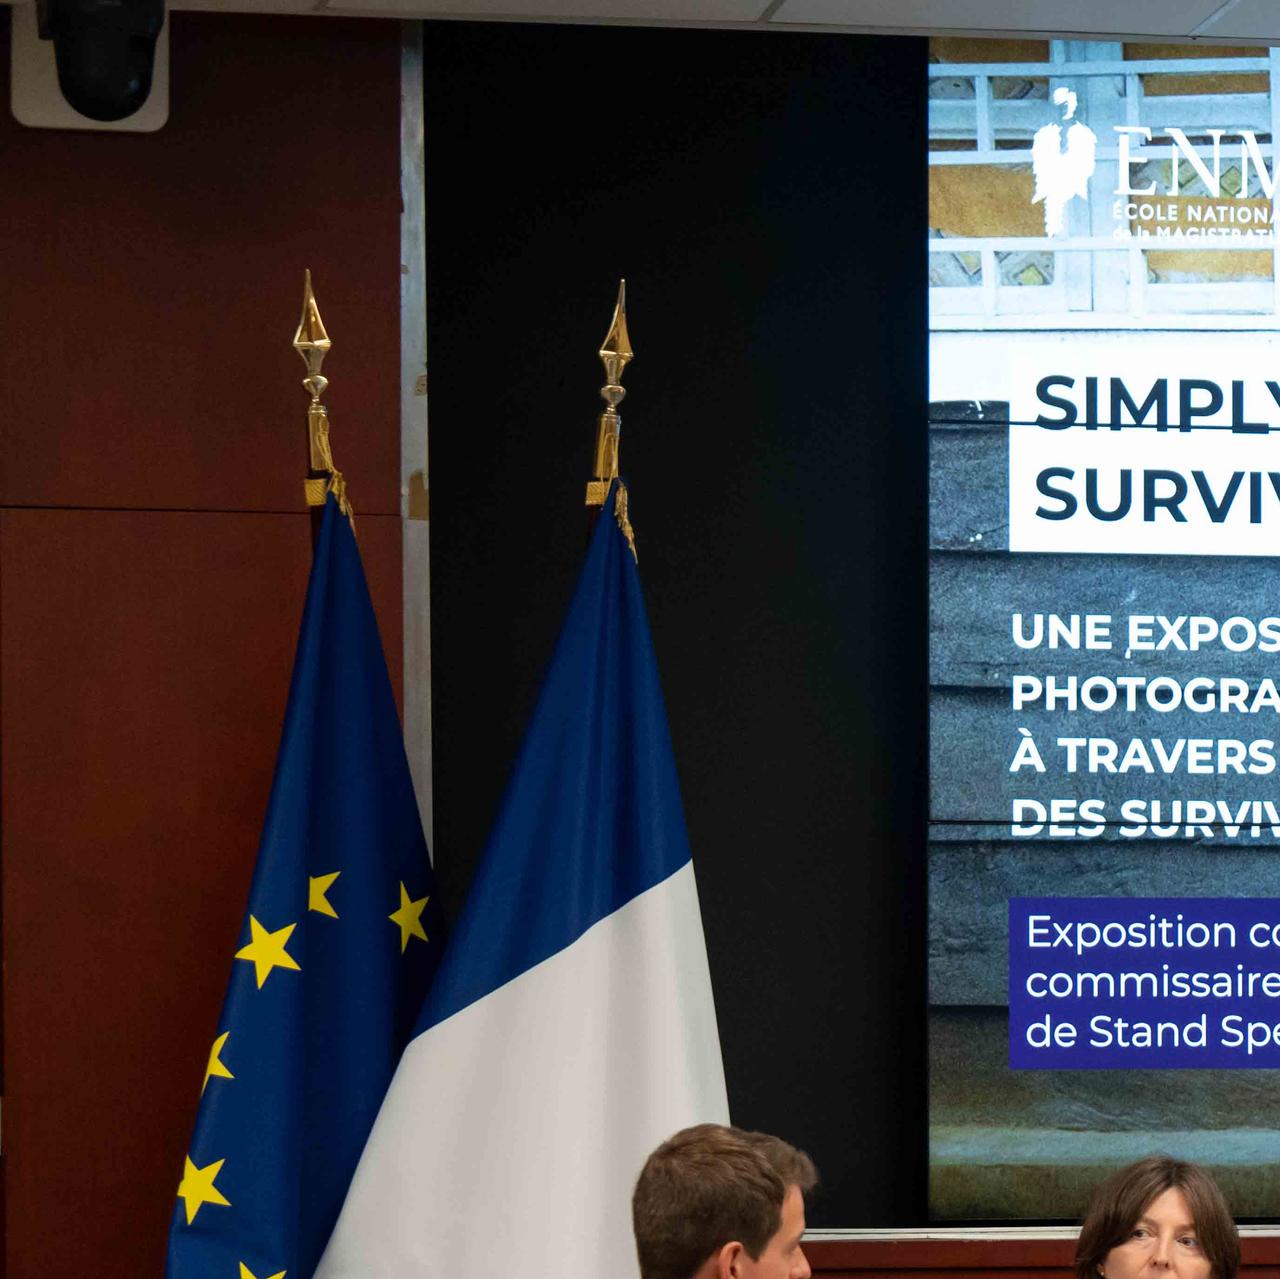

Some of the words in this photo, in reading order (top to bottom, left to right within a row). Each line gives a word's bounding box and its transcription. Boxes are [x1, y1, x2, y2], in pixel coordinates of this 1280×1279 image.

[1112, 200, 1178, 222] ÉCOLE
[1011, 613, 1113, 650] UNE
[1009, 727, 1046, 773] À
[1057, 737, 1276, 775] TRAVERS
[1011, 798, 1106, 837] DES
[1027, 914, 1237, 955] Exposition
[1026, 1014, 1078, 1048] de
[1089, 1014, 1208, 1048] Stand
